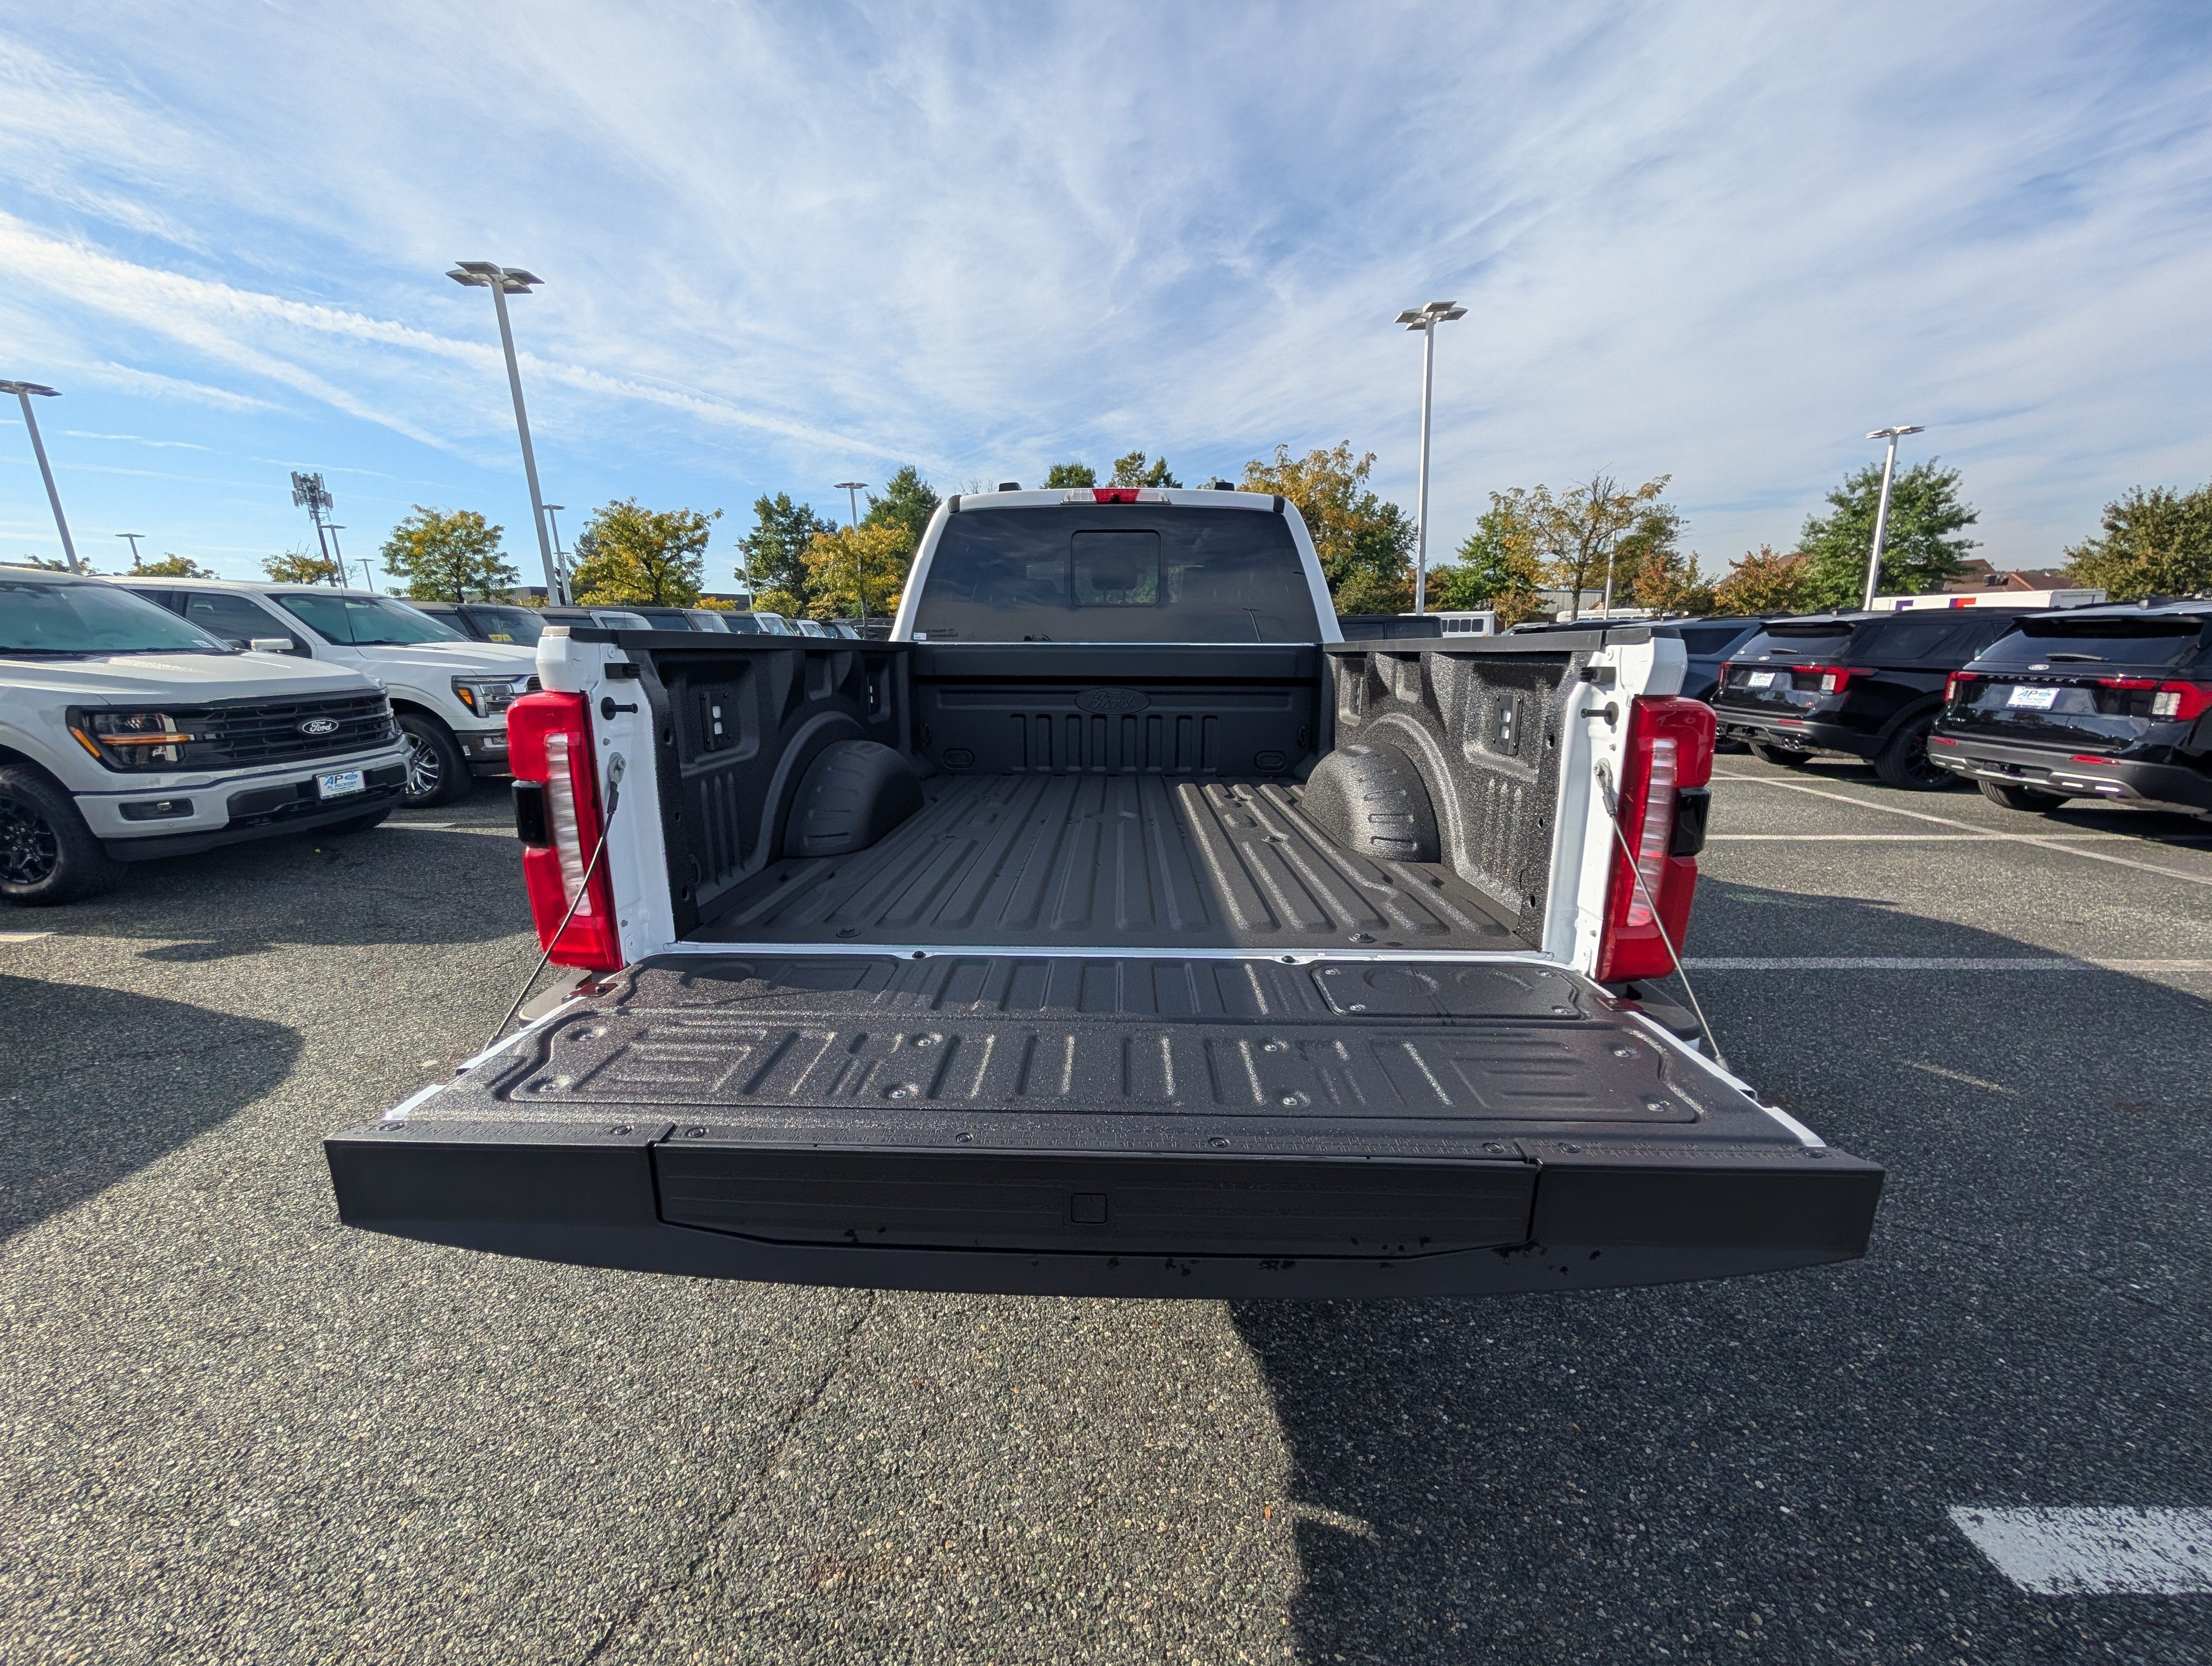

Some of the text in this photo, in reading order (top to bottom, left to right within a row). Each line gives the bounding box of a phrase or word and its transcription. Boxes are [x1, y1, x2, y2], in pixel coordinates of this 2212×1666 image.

[1089, 691, 1136, 709] Ford
[310, 721, 332, 732] Ford
[324, 774, 344, 786] AP
